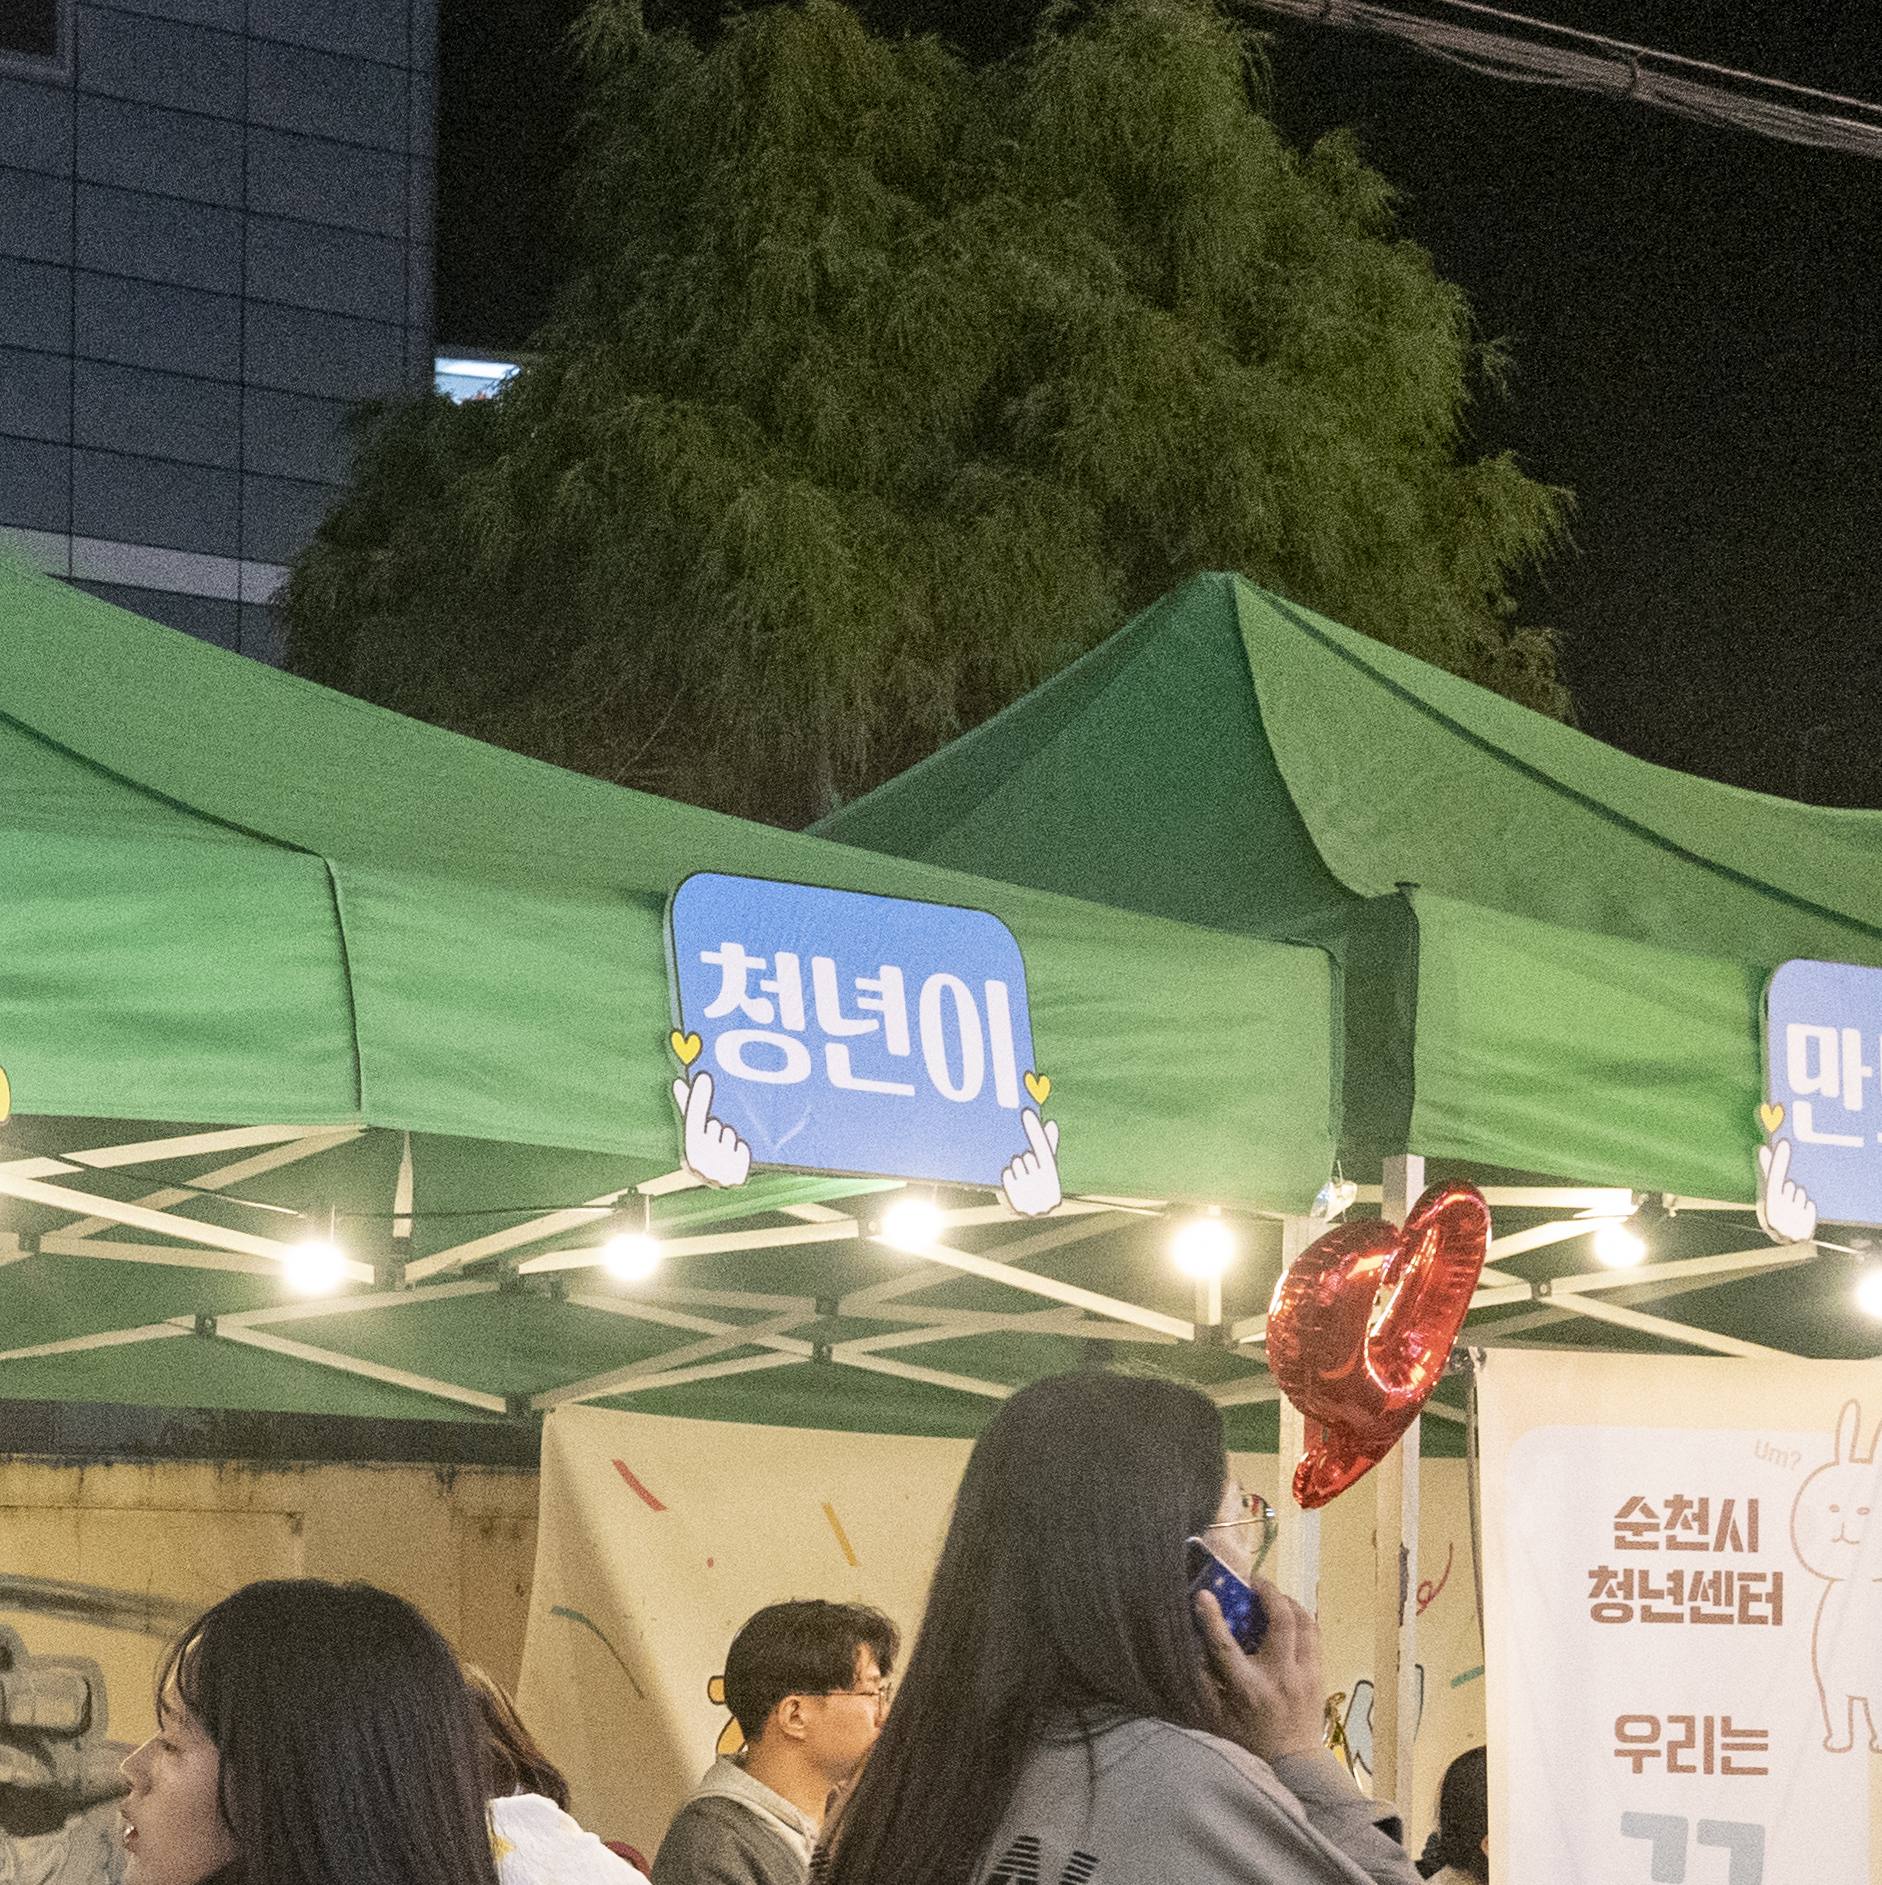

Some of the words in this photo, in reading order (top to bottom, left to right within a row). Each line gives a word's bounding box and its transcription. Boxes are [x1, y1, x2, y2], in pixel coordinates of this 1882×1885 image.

[699, 940, 1019, 1109] 청년이
[1786, 1023, 1882, 1148] 만
[1613, 1493, 1759, 1553] 순천시
[1587, 1565, 1784, 1626] 청년센터
[1613, 1714, 1769, 1775] 우리는
